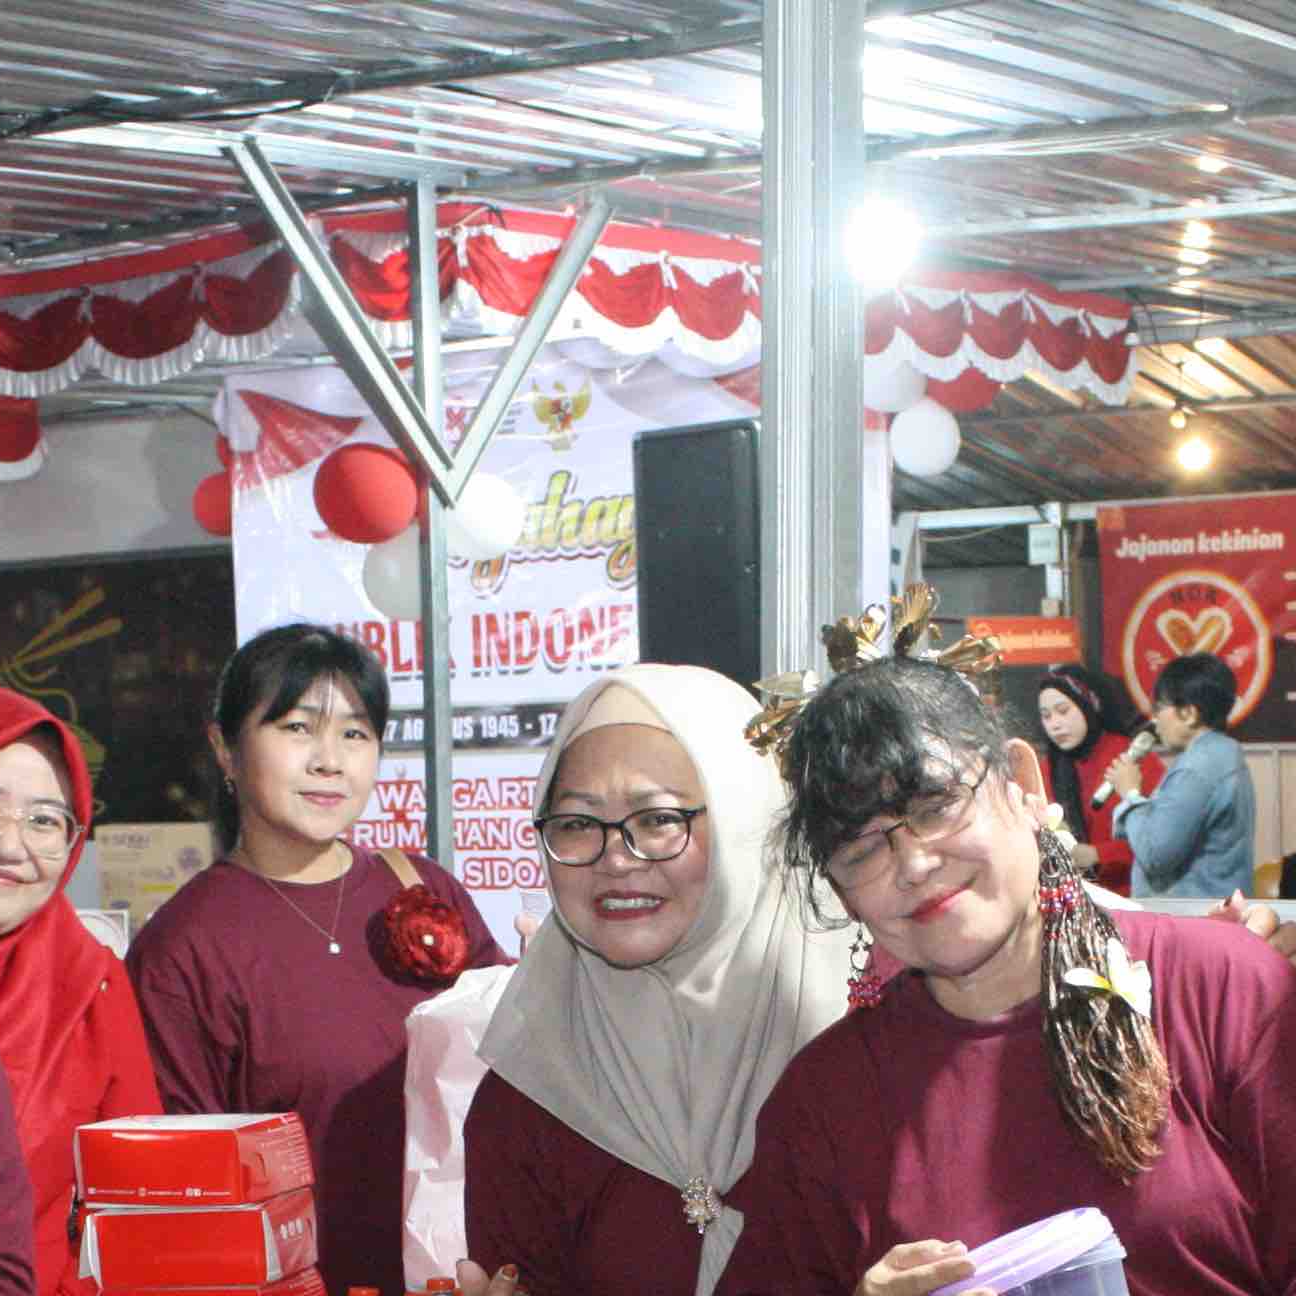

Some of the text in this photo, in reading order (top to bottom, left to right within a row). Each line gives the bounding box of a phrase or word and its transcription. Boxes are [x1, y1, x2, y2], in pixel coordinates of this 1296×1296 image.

[1197, 528, 1285, 554] kekinian
[470, 603, 634, 672] INDONE
[403, 714, 474, 742] AGUS
[480, 712, 520, 738] 1945
[376, 779, 499, 812] WAGA
